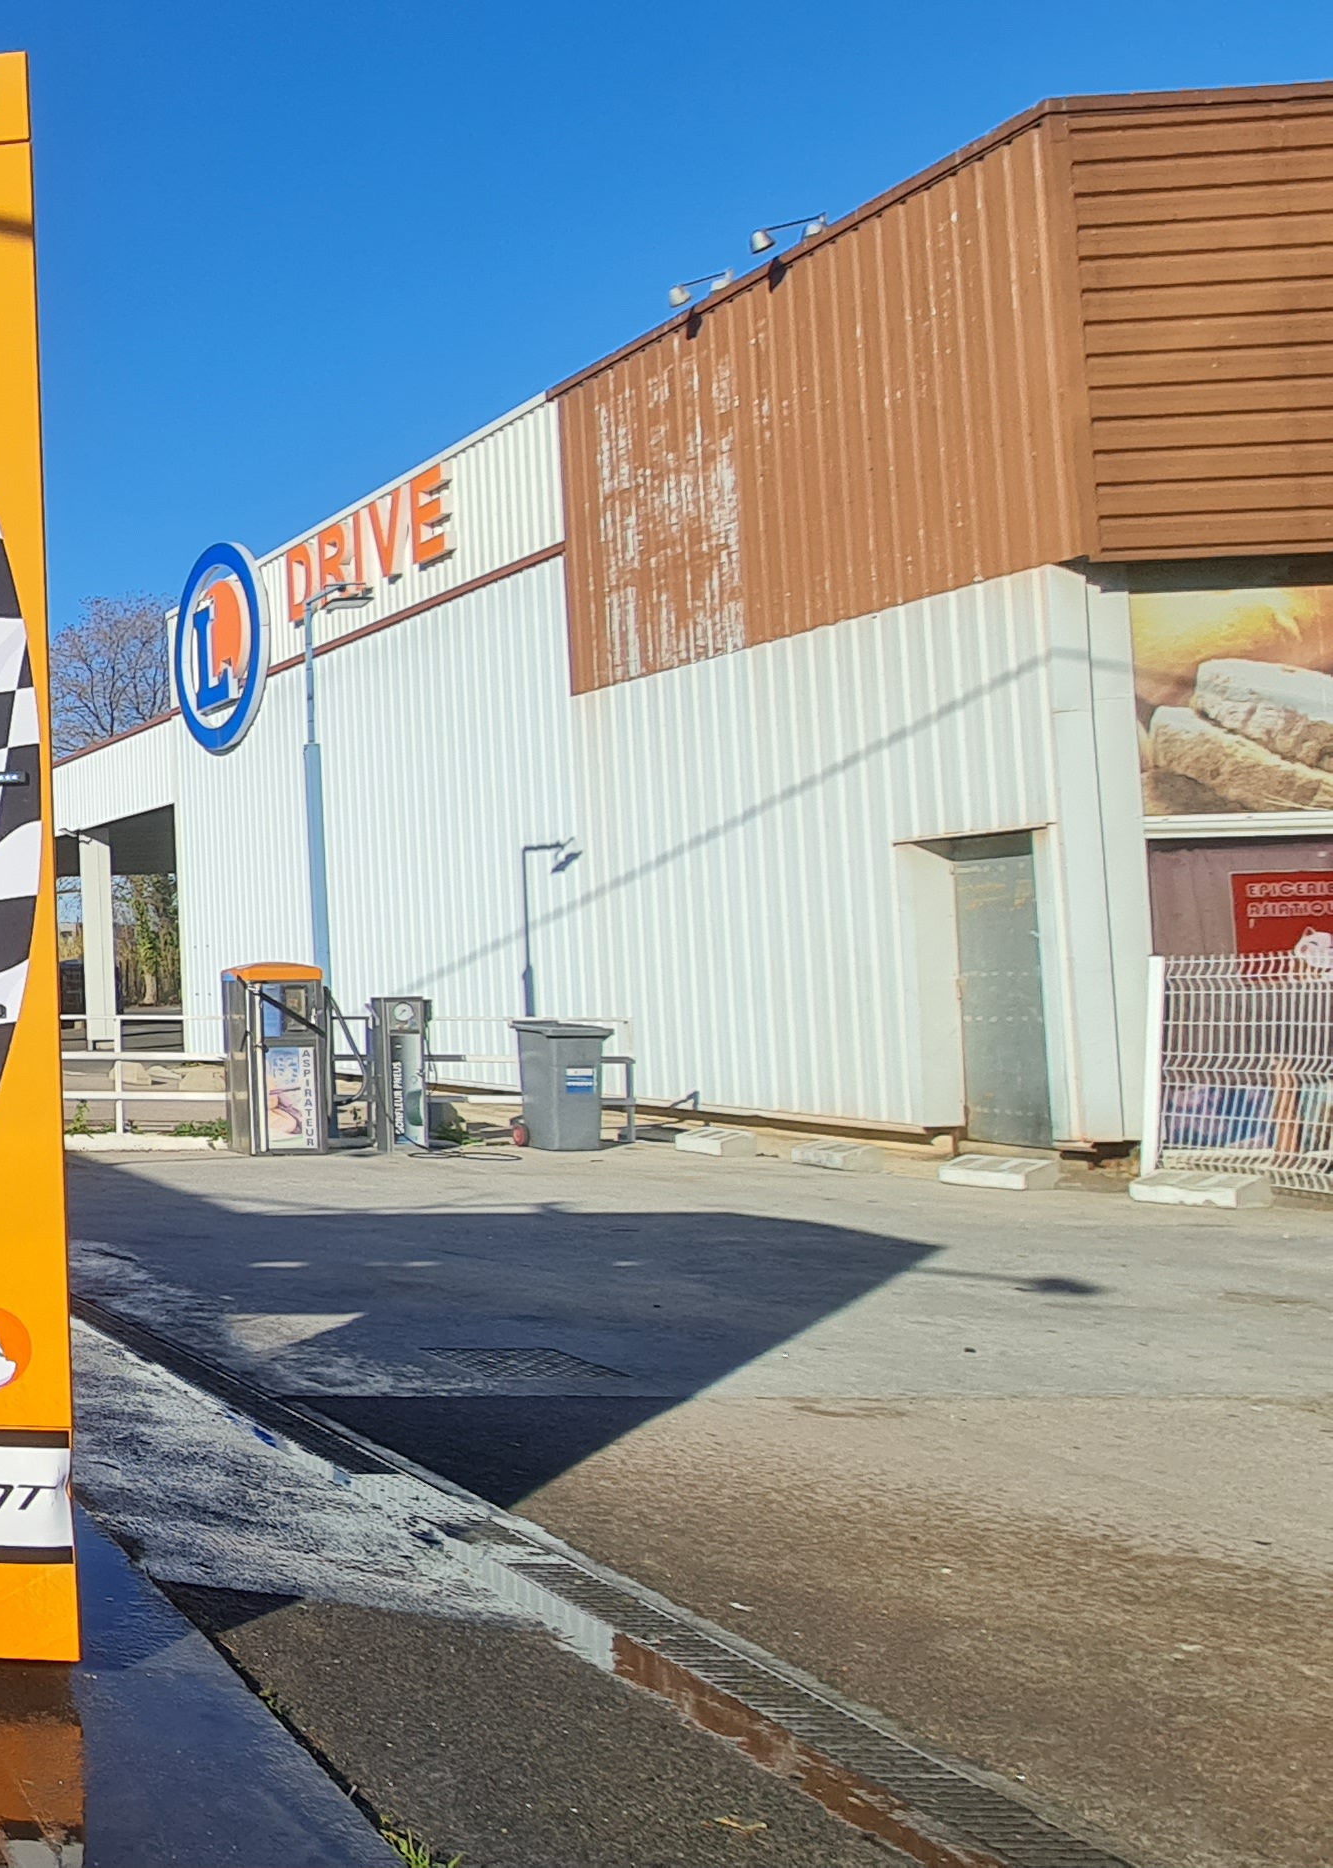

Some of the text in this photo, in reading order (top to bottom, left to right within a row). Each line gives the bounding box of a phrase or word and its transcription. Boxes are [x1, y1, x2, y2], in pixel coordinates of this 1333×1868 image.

[286, 463, 451, 624] DRIVE
[1247, 881, 1333, 897] EPICERIE
[302, 1048, 315, 1147] ASPIRATEUR
